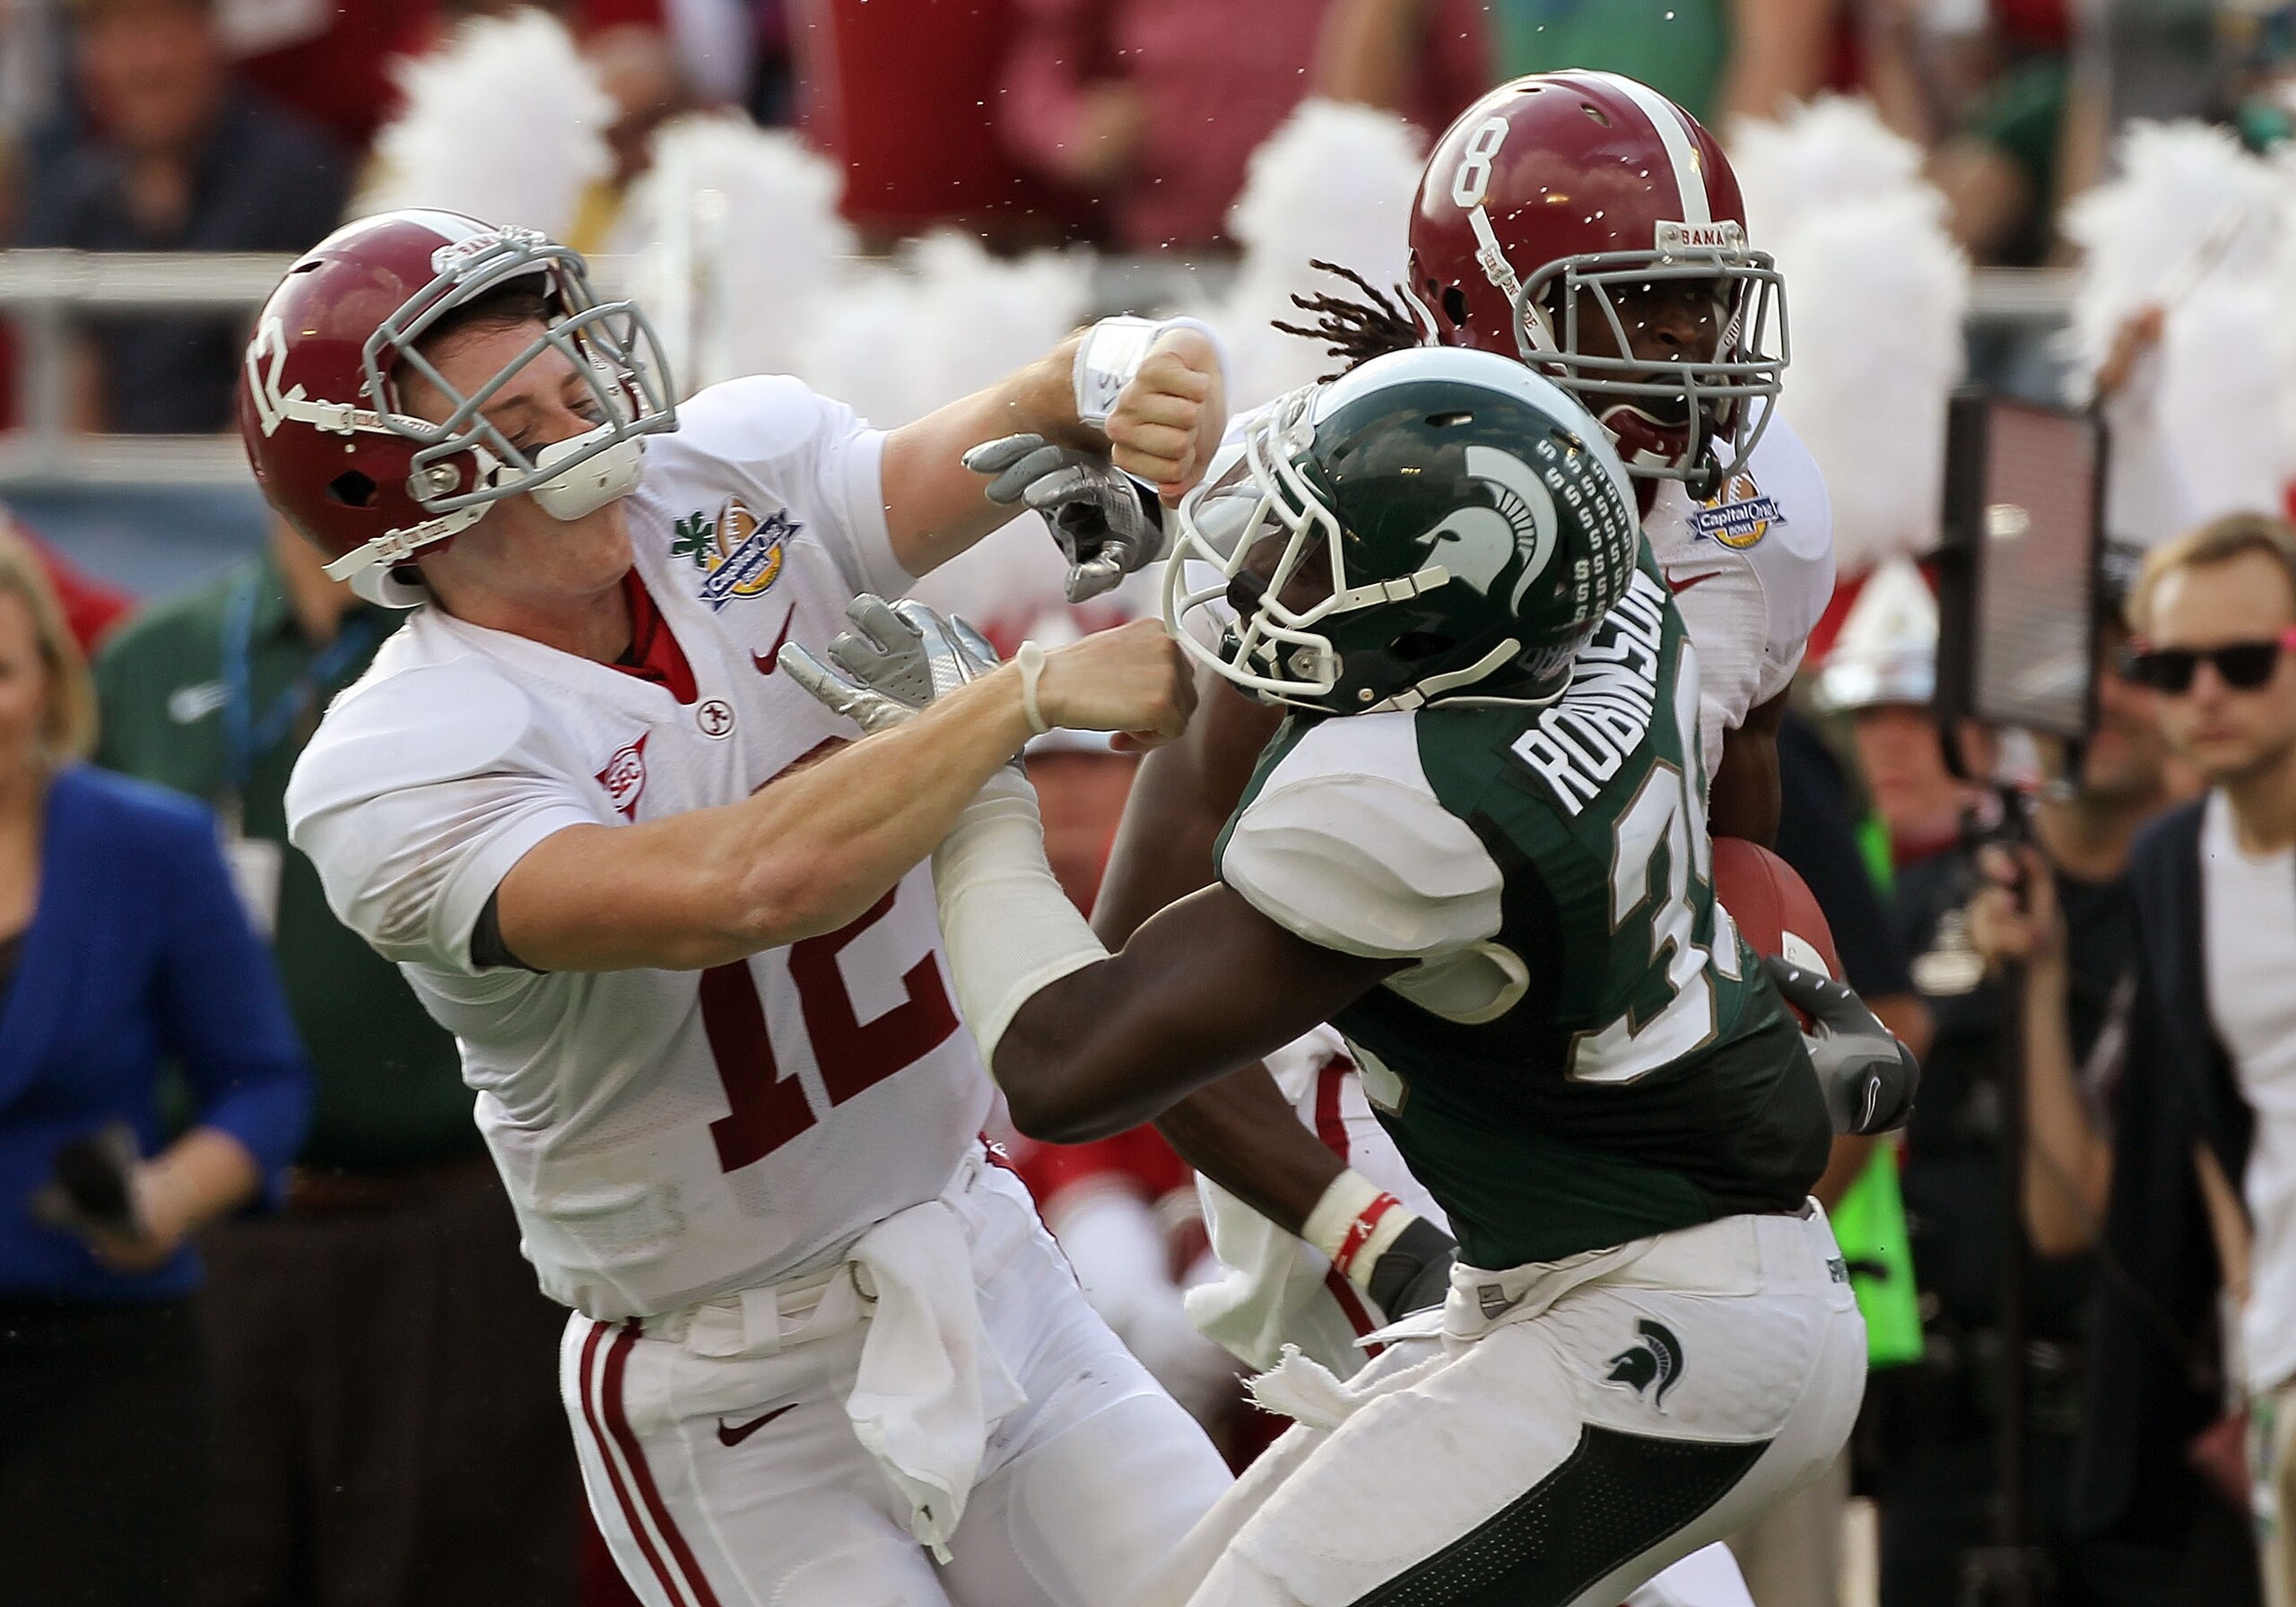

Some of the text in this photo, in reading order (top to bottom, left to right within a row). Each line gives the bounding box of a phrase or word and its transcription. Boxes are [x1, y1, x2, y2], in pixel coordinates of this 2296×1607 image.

[1453, 117, 1510, 207] 8
[1681, 230, 1725, 246] BAMA
[245, 316, 307, 438] 12
[1510, 569, 1666, 816] ROBINSON
[609, 760, 640, 799] SEC
